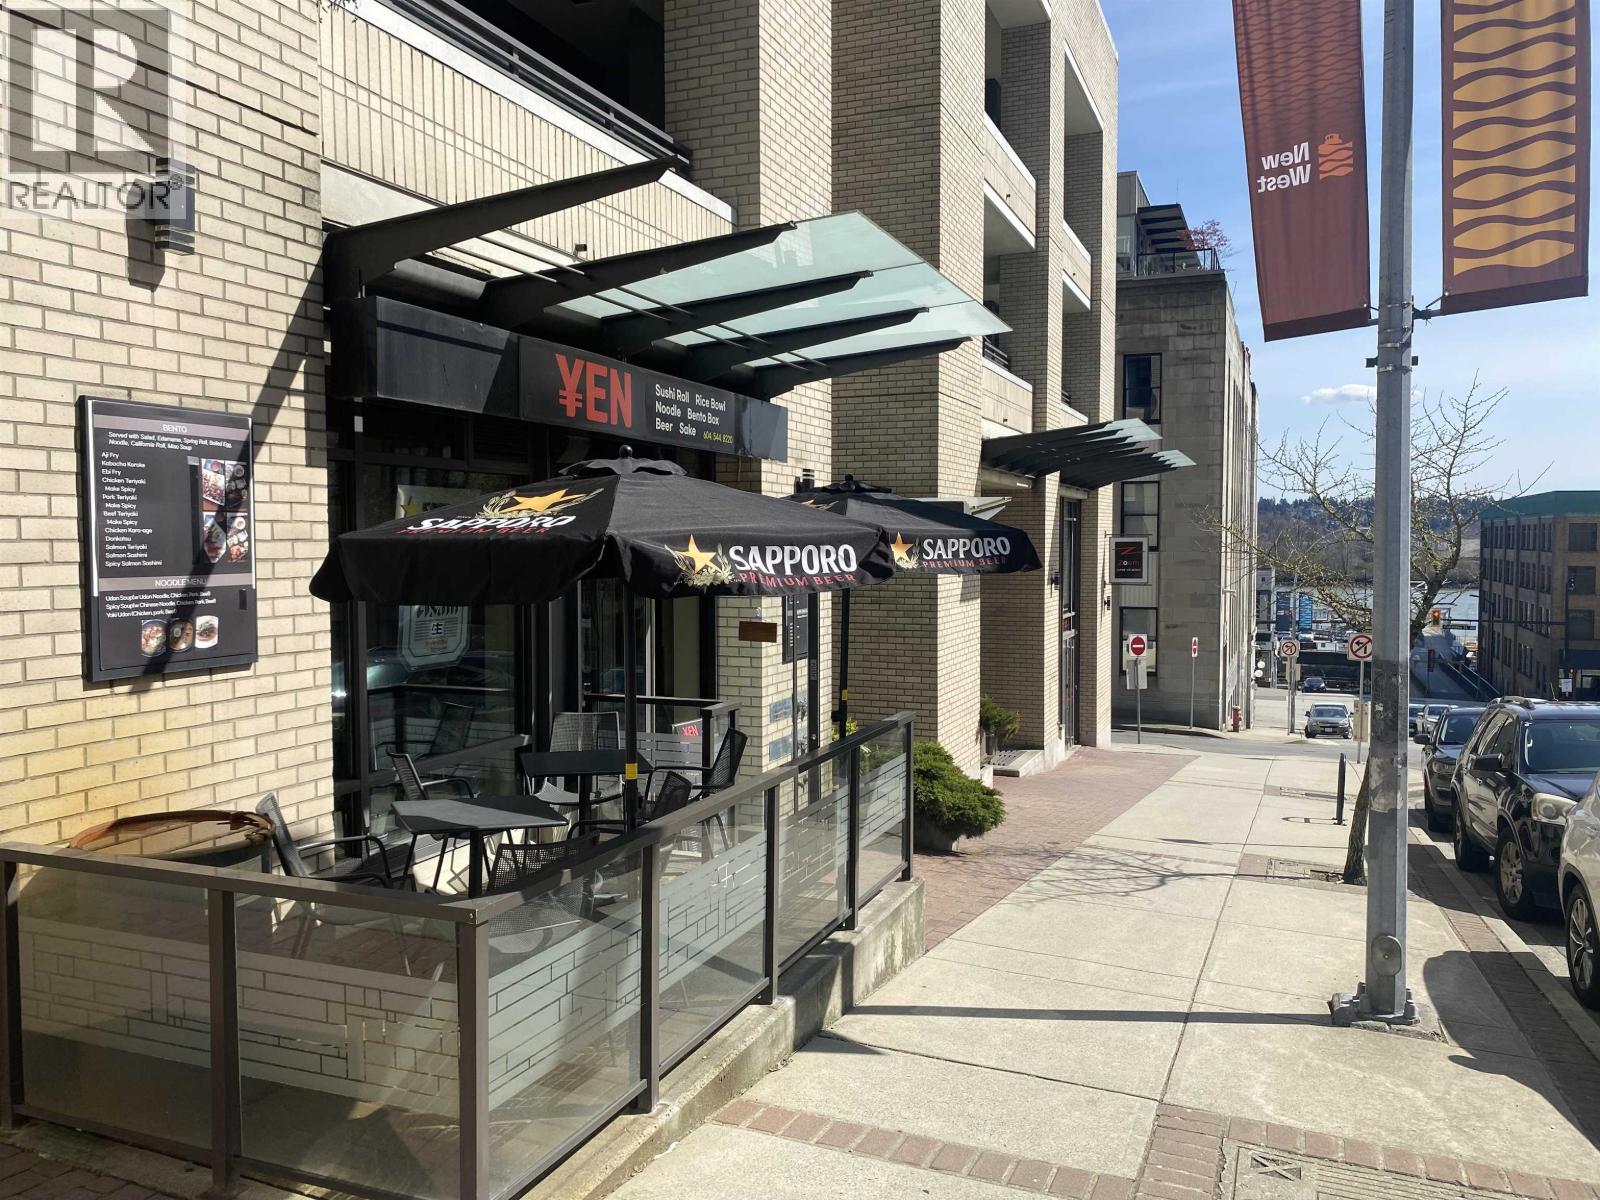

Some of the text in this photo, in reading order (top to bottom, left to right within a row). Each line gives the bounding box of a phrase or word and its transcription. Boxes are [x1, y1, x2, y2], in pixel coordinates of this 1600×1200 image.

[655, 383, 726, 412] Sushi Roll Rice Bowl
[655, 401, 720, 427] Noodle Bento Box
[162, 424, 188, 433] BENTO
[655, 417, 697, 437] Beer Sake
[108, 431, 128, 439] Served
[108, 438, 129, 446] Noodle,
[130, 440, 155, 448] California
[109, 451, 120, 459] Fry
[111, 468, 122, 476] Fry
[101, 476, 147, 485] Chicken Teriyaki
[120, 485, 136, 493] Spicy
[121, 502, 137, 510] Spicy
[117, 510, 139, 518] Teriyaki
[407, 515, 577, 531] SAPPORO
[922, 536, 1012, 560] SAPPORO
[105, 560, 121, 568] Spicy
[728, 543, 858, 576] SAPPORO
[922, 556, 1008, 570] PREMIUM BEER
[154, 577, 208, 588] NOODLE MENU
[738, 571, 858, 589] PREMIUM BEER
